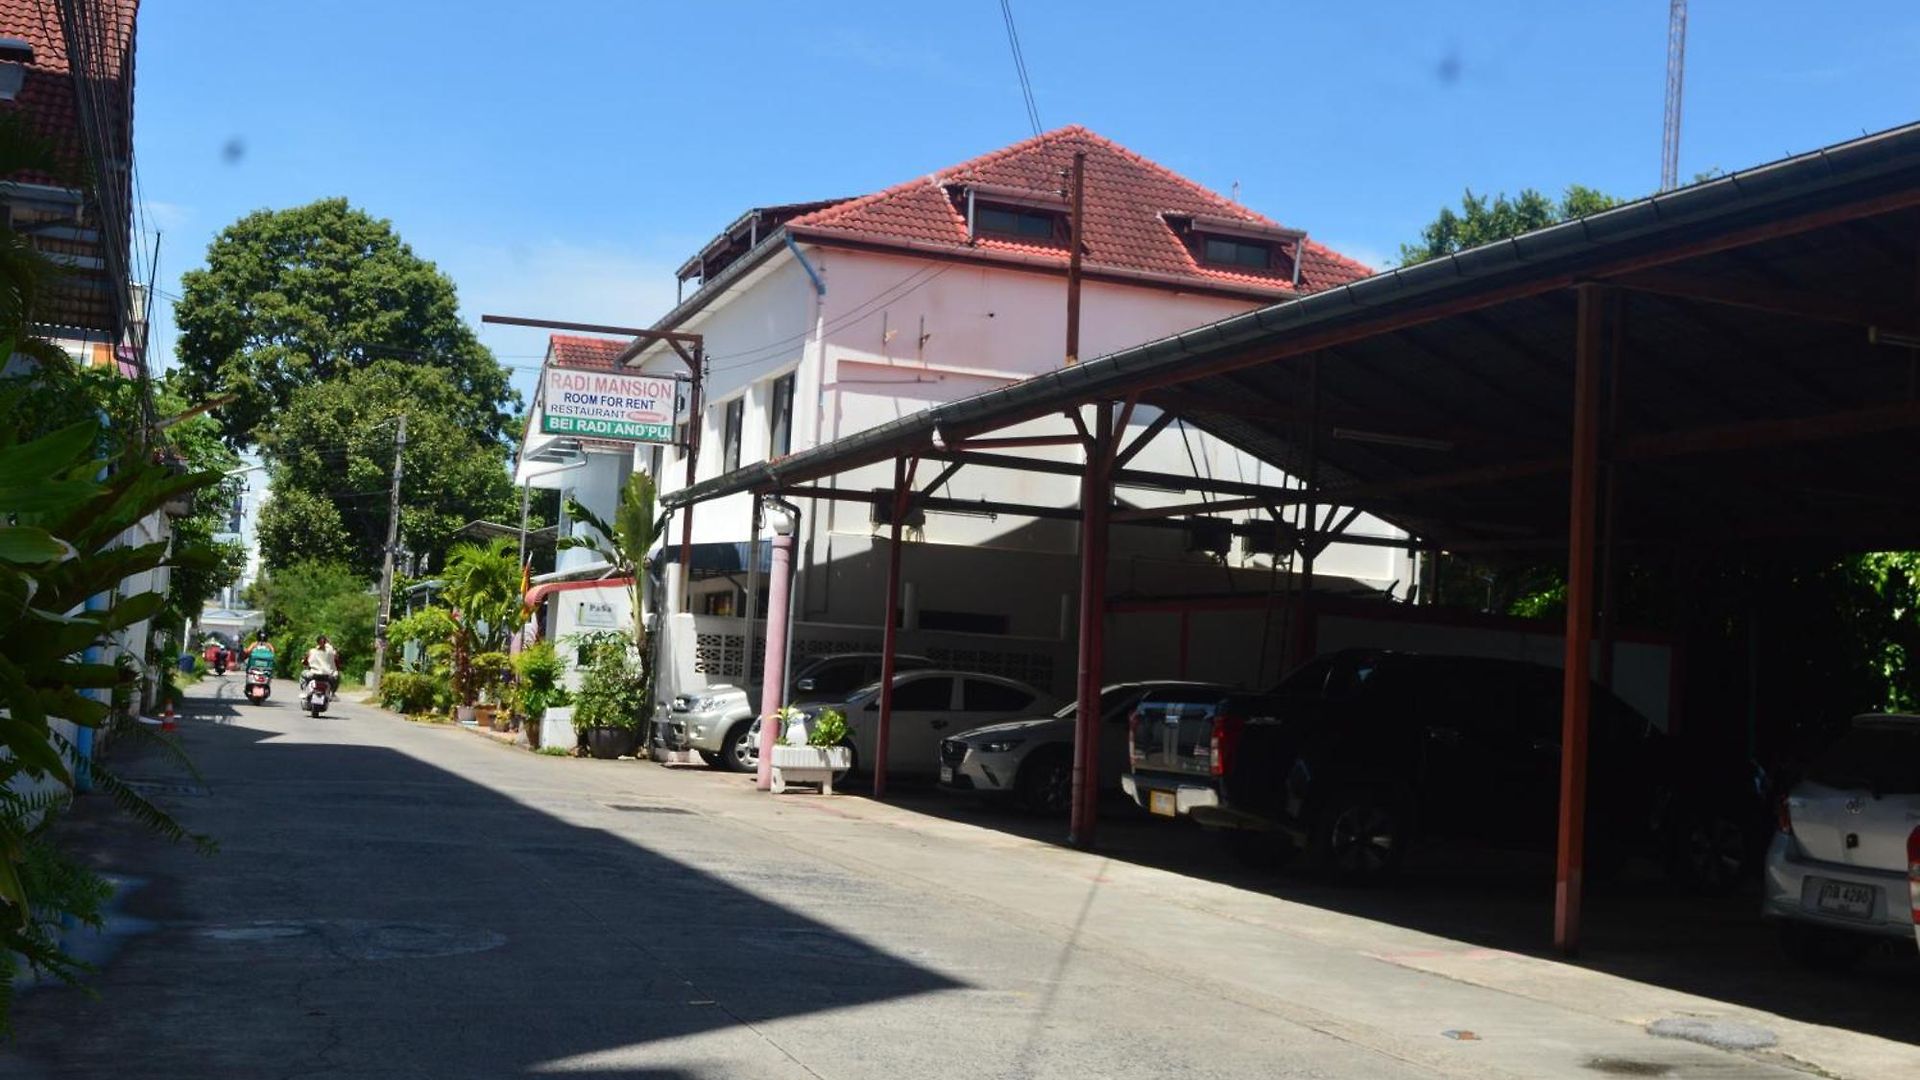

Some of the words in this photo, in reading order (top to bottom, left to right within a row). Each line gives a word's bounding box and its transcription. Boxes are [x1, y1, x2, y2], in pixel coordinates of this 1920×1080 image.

[551, 373, 590, 392] RADI
[595, 379, 672, 400] MANSION
[564, 392, 598, 405] ROOM
[601, 395, 623, 408] FOR
[625, 398, 656, 410] RENT
[551, 404, 626, 418] RESTAURANT
[549, 417, 573, 430] BEI
[577, 420, 611, 434] RADI
